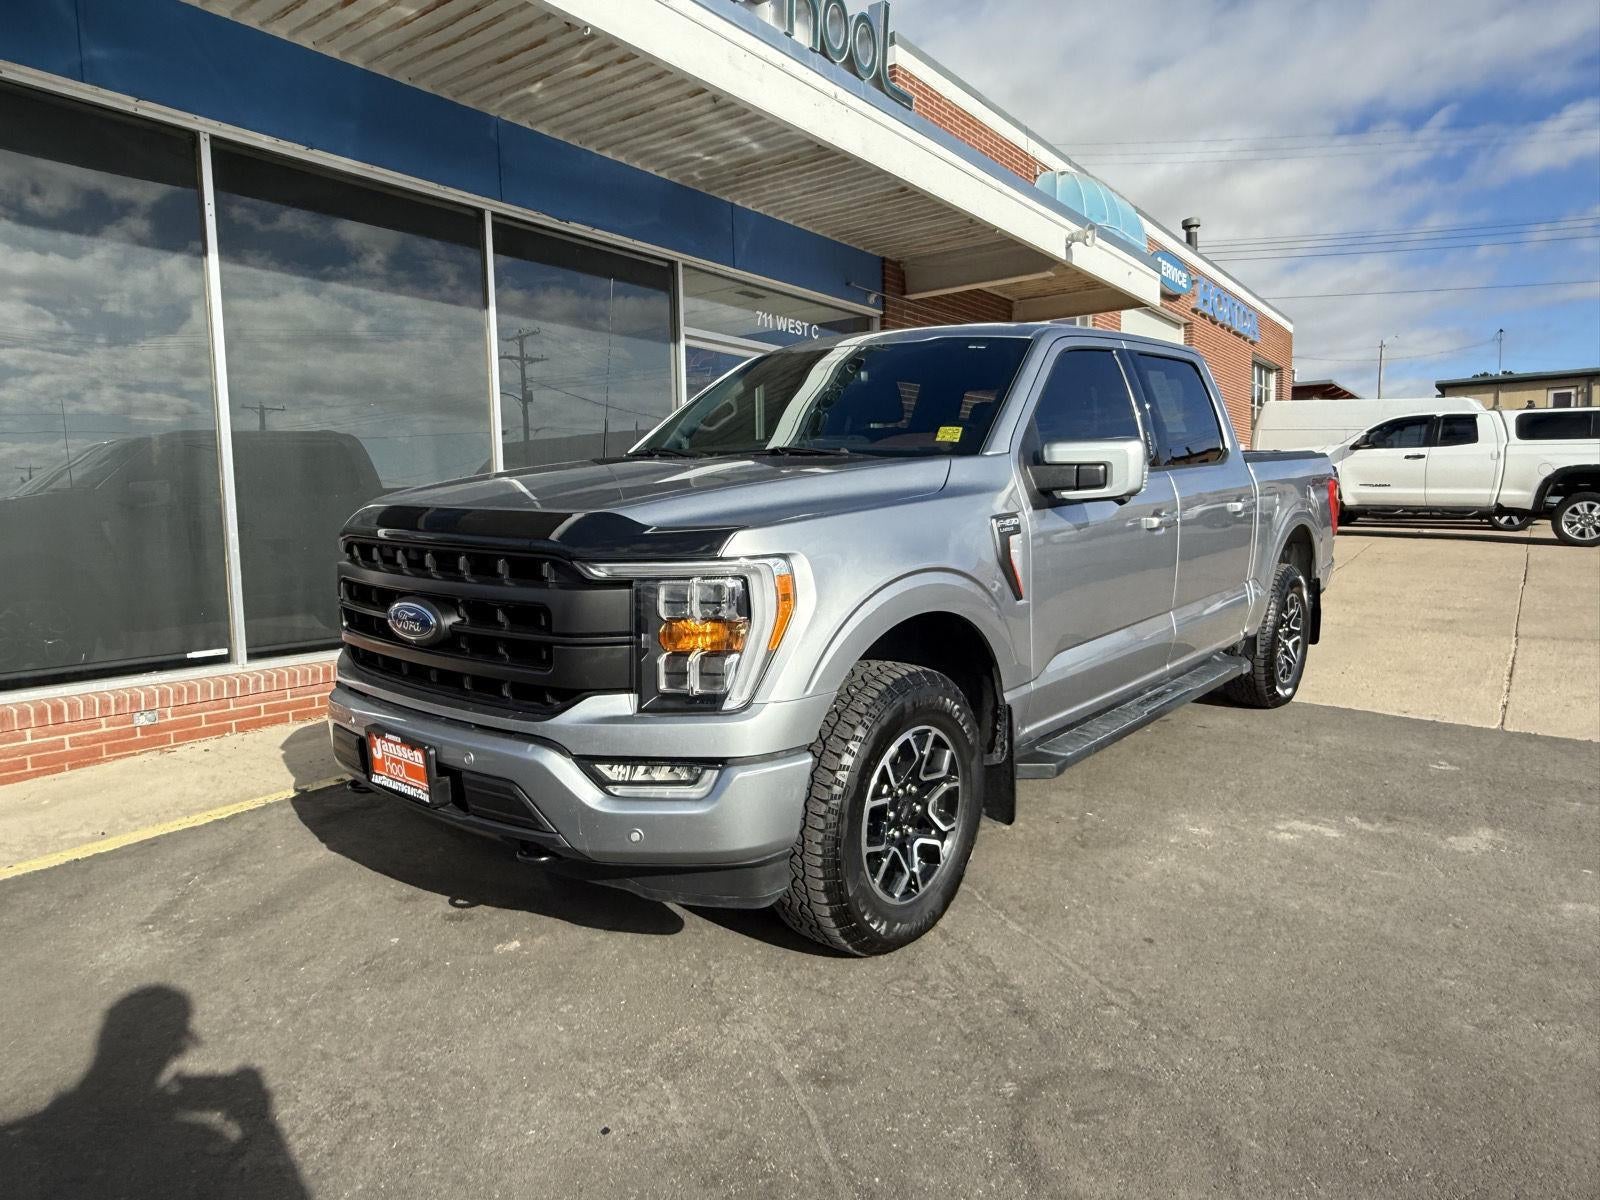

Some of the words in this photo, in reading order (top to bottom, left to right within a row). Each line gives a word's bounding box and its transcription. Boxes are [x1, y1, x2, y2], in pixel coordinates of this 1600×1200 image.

[1157, 256, 1189, 289] ERVICE
[755, 310, 773, 329] 711
[776, 315, 809, 337] WEST
[811, 324, 819, 340] C
[396, 609, 422, 632] Ford
[372, 735, 424, 764] Janssen
